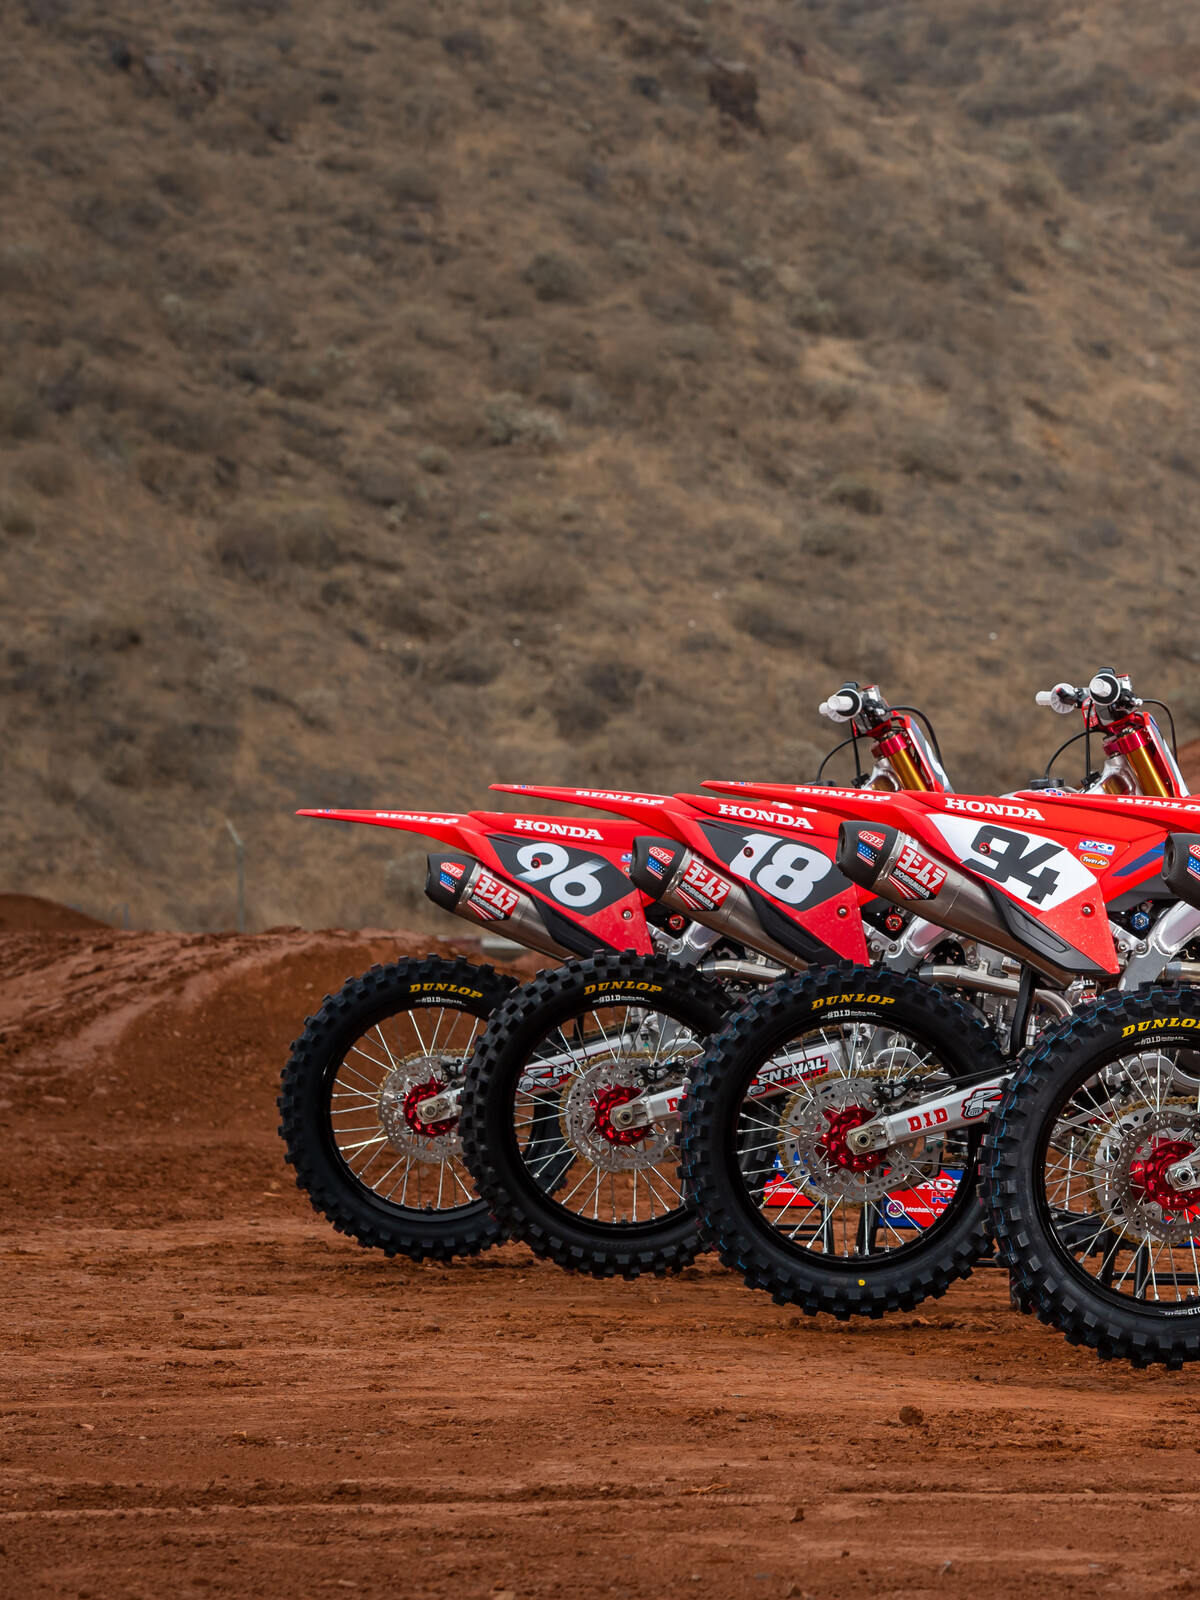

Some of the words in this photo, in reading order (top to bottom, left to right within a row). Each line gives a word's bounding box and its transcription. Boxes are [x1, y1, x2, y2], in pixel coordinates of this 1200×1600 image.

[718, 803, 814, 830] HONDA
[944, 797, 1045, 822] HONDA
[513, 819, 604, 841] HONDA
[512, 842, 609, 908] 96
[729, 833, 833, 905] 18
[897, 848, 947, 890] ヨシムラ
[960, 824, 1065, 905] 94
[474, 875, 518, 912] ヨシムラ
[684, 862, 729, 901] ヨシムラ
[409, 982, 484, 998] DUNLOP
[583, 980, 663, 996] DUNLOP
[811, 993, 896, 1011] DUNLOP
[758, 1057, 828, 1086] ENTHAL
[907, 1107, 949, 1132] D.I.D
